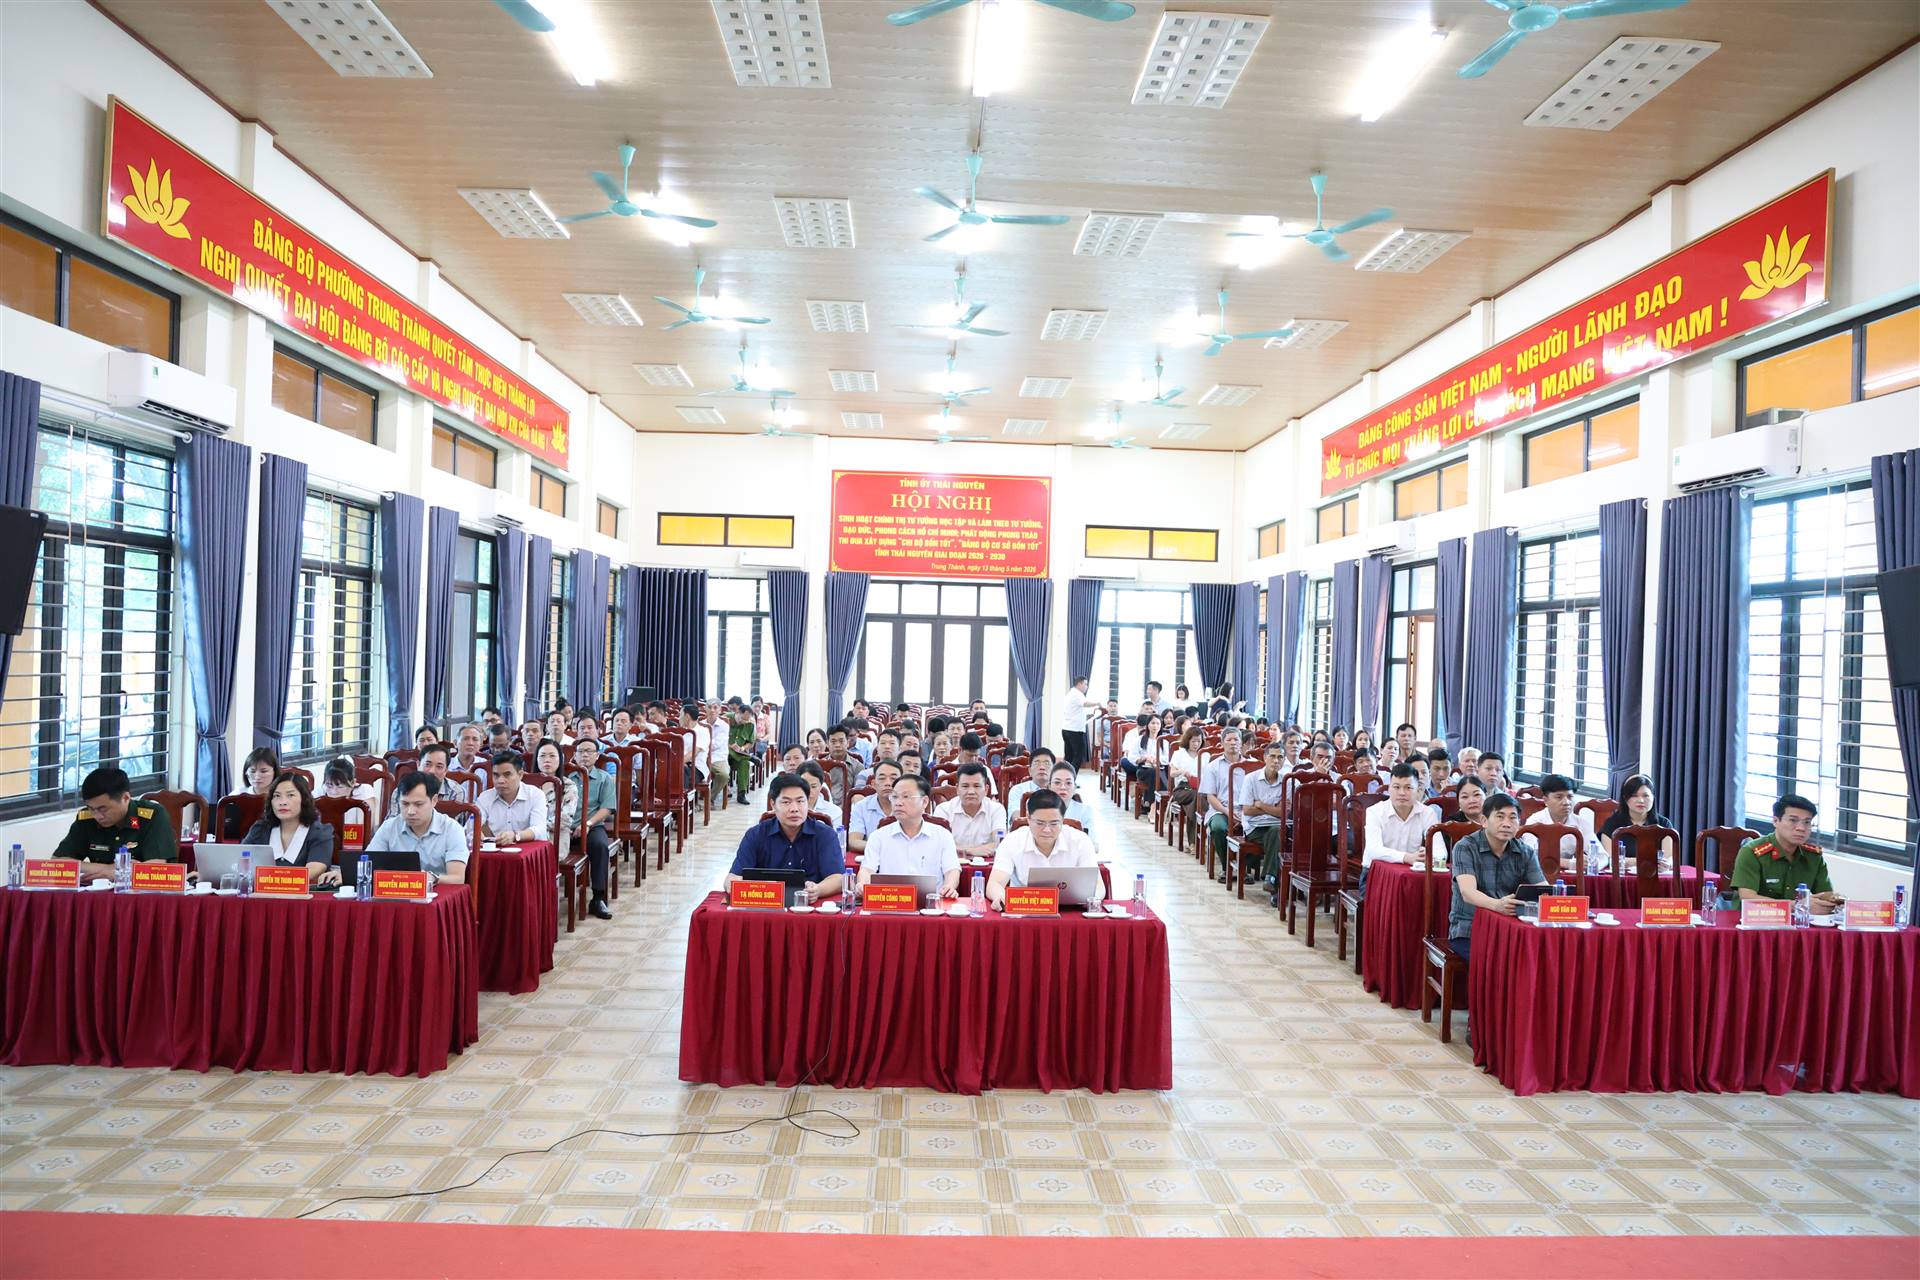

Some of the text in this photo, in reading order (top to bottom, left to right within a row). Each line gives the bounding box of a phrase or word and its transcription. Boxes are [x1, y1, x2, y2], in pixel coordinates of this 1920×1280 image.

[253, 216, 294, 268] ĐẢNG
[296, 246, 315, 286] BỘ
[317, 259, 365, 312] PHƯỜNG
[367, 290, 401, 333] TRUNG
[402, 312, 431, 353] THÀNH
[431, 335, 456, 368] QUYẾT
[457, 349, 474, 379] TÂM
[294, 290, 317, 330] ĐẠI
[318, 304, 340, 342] HỘI
[342, 315, 373, 357] ĐẢNG
[391, 346, 410, 377] CÁC
[411, 355, 429, 386] CẤP
[431, 369, 441, 394] VÀ
[1358, 423, 1383, 450] ĐẢNG
[1385, 411, 1412, 437] CỘNG
[1414, 393, 1438, 423] SẢN
[1440, 380, 1467, 410] VIỆT
[1469, 362, 1502, 397] NAM
[1516, 328, 1569, 376] NGƯỜI
[1573, 301, 1628, 350] LÃNH
[1634, 274, 1684, 321] ĐẠO
[1345, 454, 1356, 480] TỔ
[1356, 449, 1380, 476] CHỨC
[1382, 441, 1401, 466] MỌI
[1442, 413, 1462, 441] LỢI
[1541, 357, 1595, 401] MẠNG
[1655, 304, 1713, 352] NAM
[1719, 296, 1729, 328] !
[900, 477, 918, 488] TỈNH
[933, 479, 951, 489] THÁI
[953, 481, 985, 490] NGUYÊN
[892, 490, 992, 514] HỘI NGHỊ
[856, 515, 873, 524] HOẠT
[874, 515, 895, 524] CHÍNH
[954, 518, 967, 526] TẬP
[968, 518, 977, 526] VÀ
[978, 518, 992, 527] LÀM
[993, 519, 1010, 528] THEO
[875, 526, 897, 535] PHONG
[898, 526, 916, 535] CÁCH
[917, 526, 926, 536] HỒ
[928, 527, 939, 536] CHÍ
[961, 529, 977, 537] PHÁT
[978, 530, 997, 539] ĐỘNG
[998, 530, 1020, 539] PHONG
[1022, 530, 1039, 540] TRÀO
[850, 537, 863, 545] ĐUA
[864, 536, 877, 545] XÂY
[914, 538, 924, 547] BỘ
[981, 541, 991, 550] BỘ
[875, 547, 890, 557] TỈNH
[891, 549, 905, 557] THÁI
[906, 549, 933, 558] NGUYÊN
[934, 550, 947, 558] GIAI
[949, 551, 967, 560] ĐOẠN
[931, 562, 947, 572] Trung
[967, 565, 981, 573] ngày
[990, 565, 1005, 573] tháng
[740, 890, 747, 899] TẠ
[867, 892, 885, 902] NGUYỄN
[1010, 896, 1029, 905] NGUYỄN
